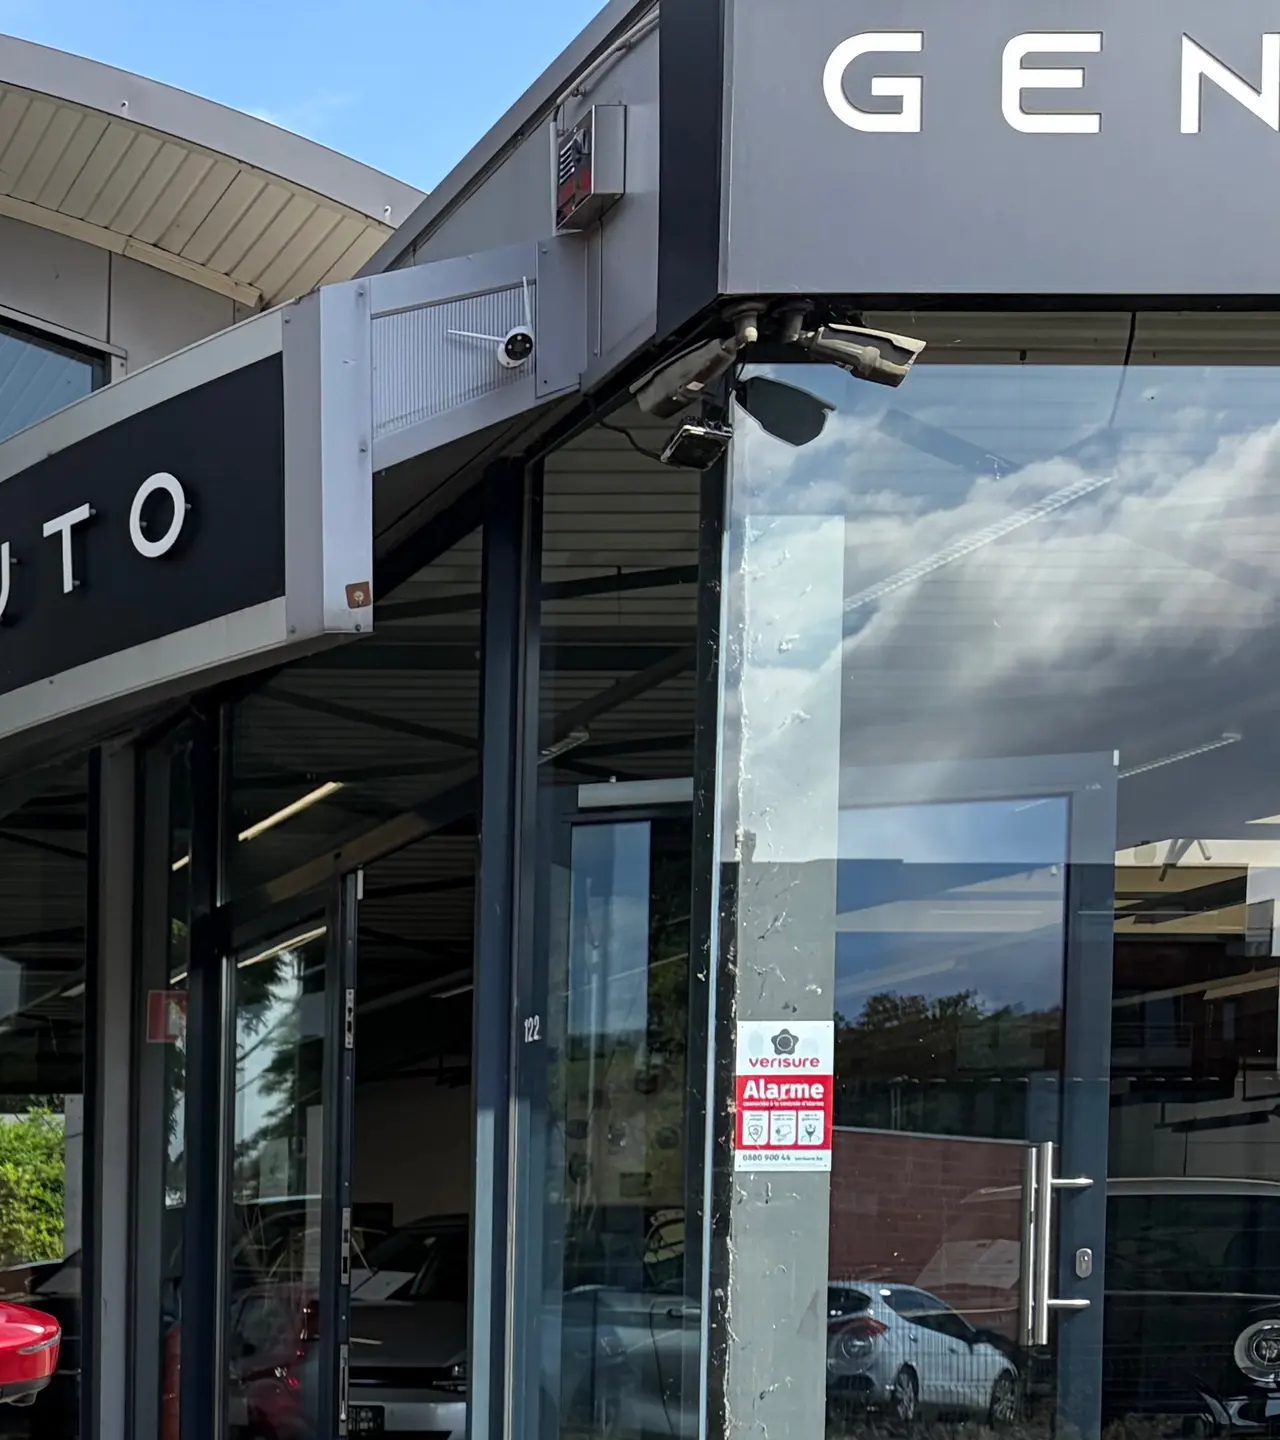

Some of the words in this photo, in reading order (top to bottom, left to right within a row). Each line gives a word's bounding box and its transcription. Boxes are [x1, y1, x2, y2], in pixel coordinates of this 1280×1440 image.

[822, 31, 1280, 134] GEN
[524, 1014, 542, 1044] 122
[749, 1057, 820, 1068] verisure
[743, 1079, 824, 1099] Alarme
[743, 1154, 762, 1162] 0800
[764, 1154, 780, 1162] 900
